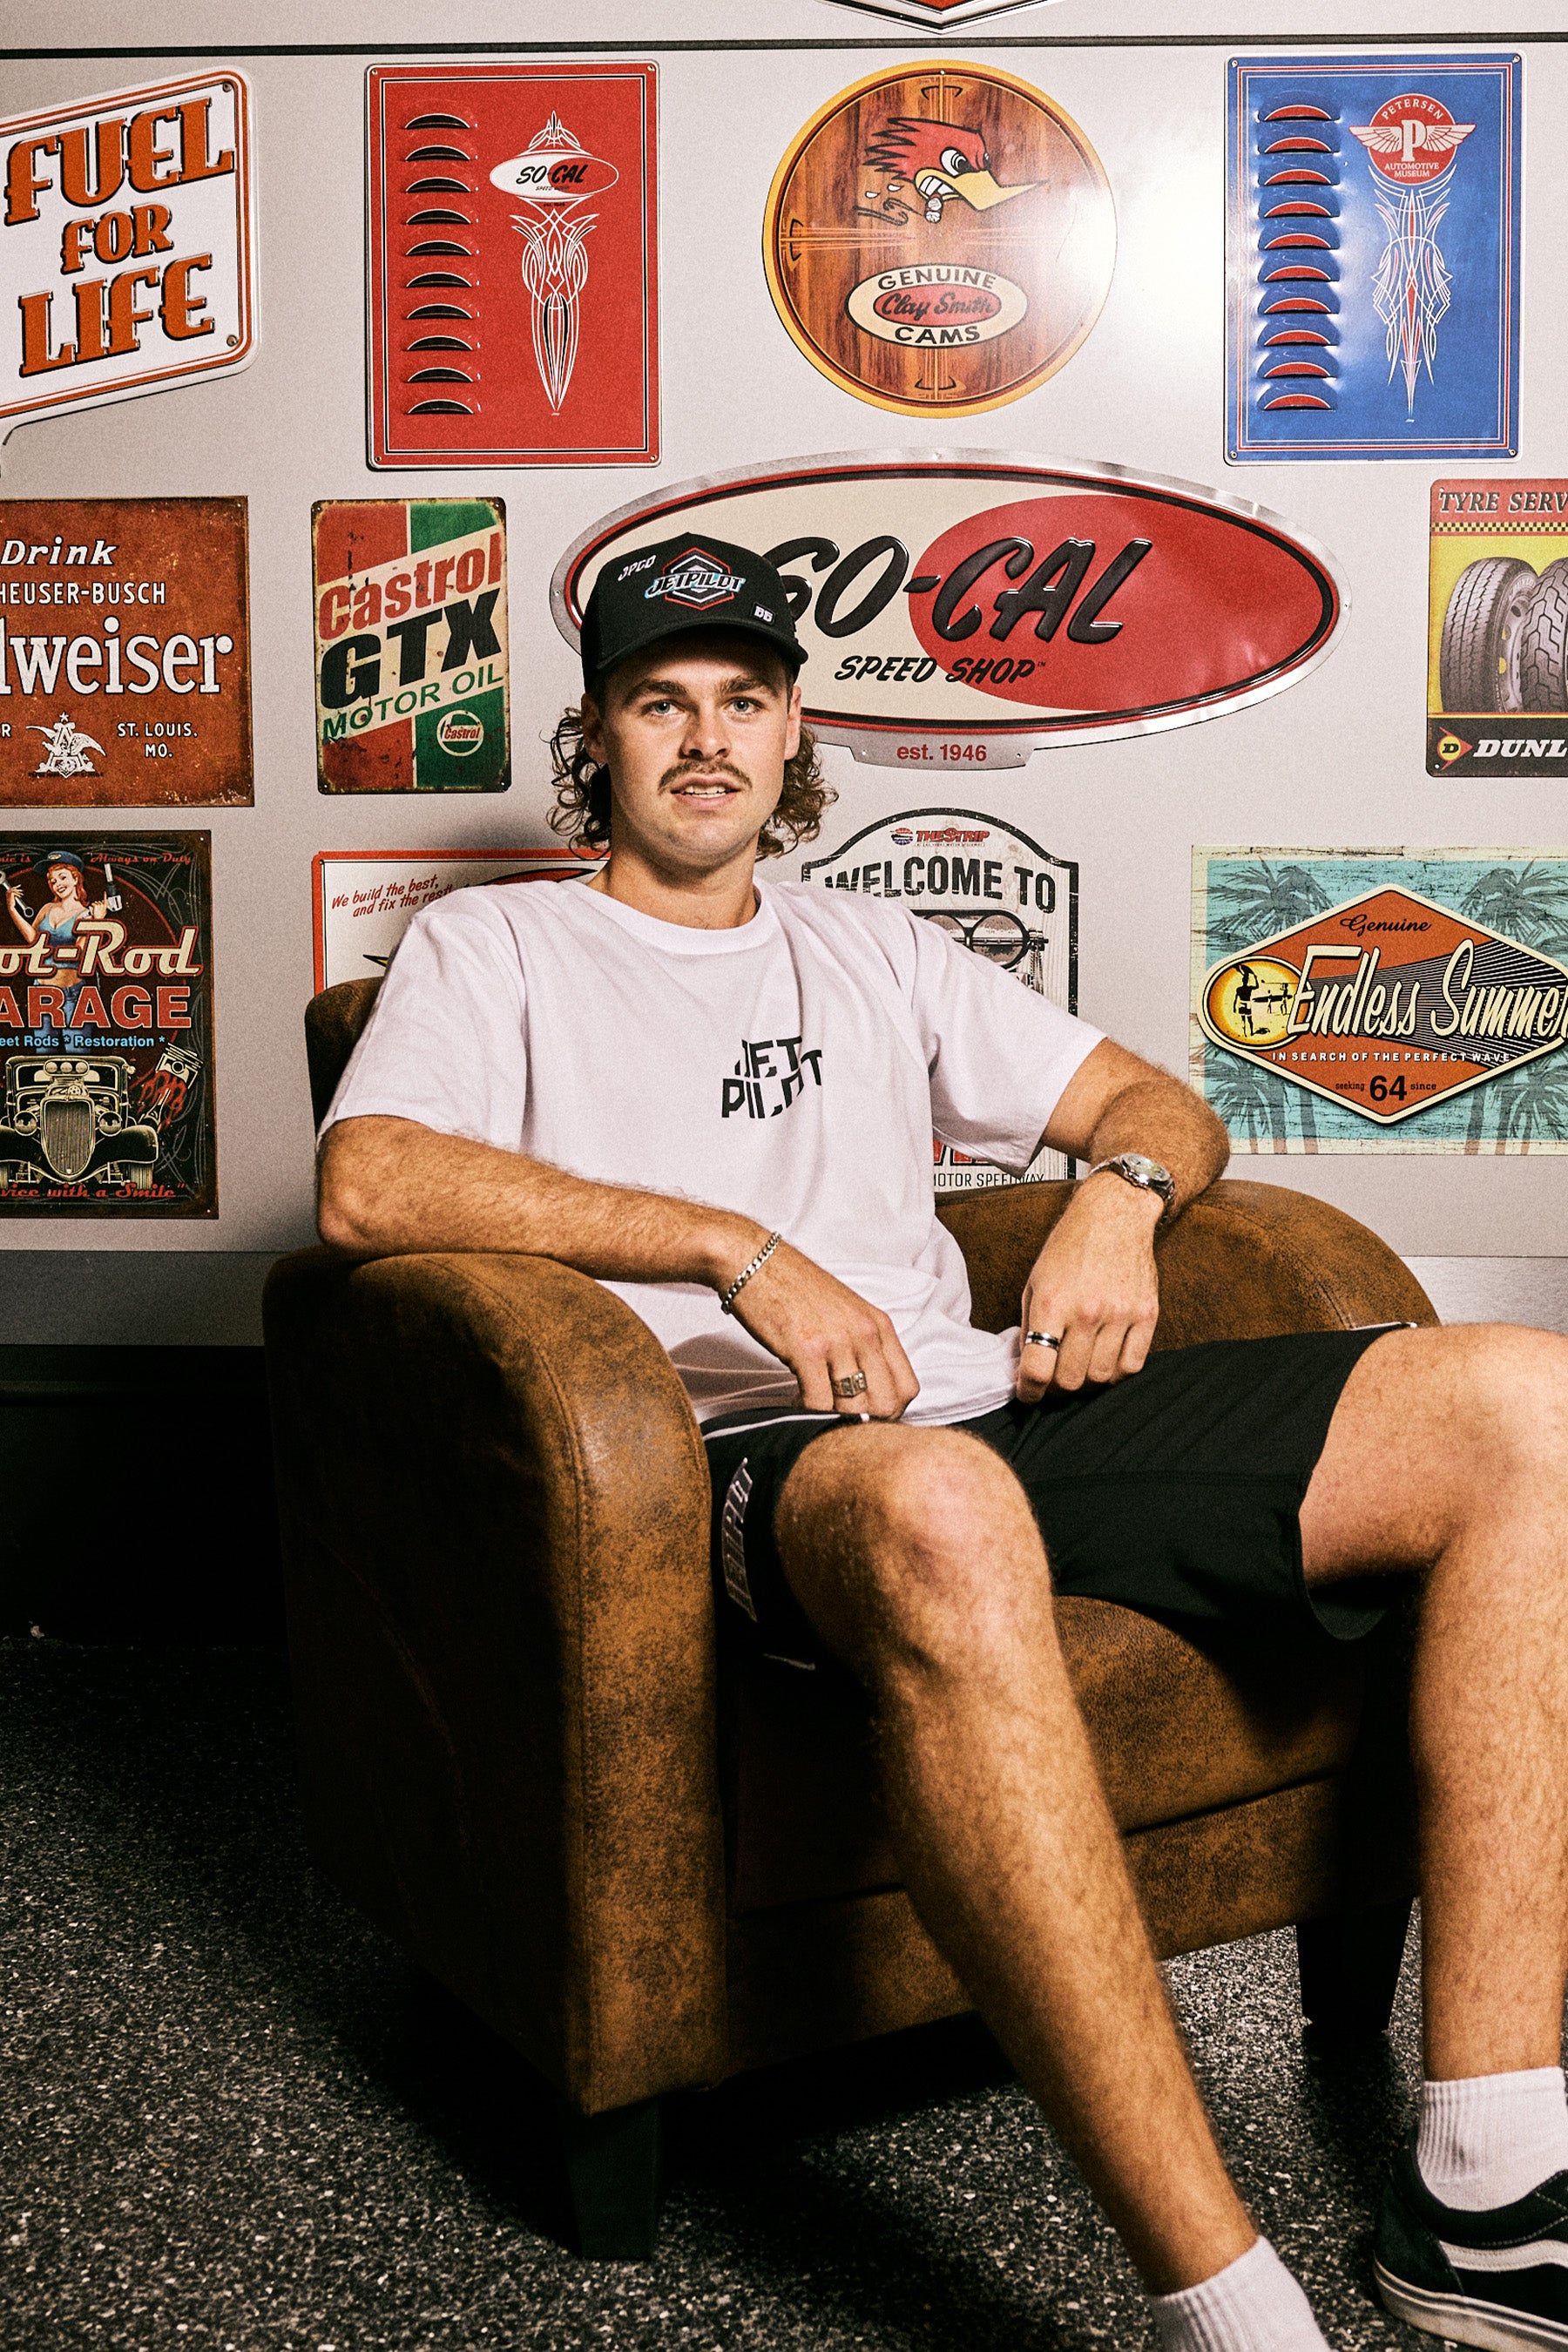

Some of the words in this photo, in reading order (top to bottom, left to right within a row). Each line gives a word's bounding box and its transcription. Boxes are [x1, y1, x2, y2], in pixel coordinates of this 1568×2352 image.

[1382, 98, 1443, 120] PETERSEN
[3, 98, 235, 226] FUEL
[61, 204, 173, 274] FOR
[878, 268, 997, 290] GENUINE
[19, 253, 215, 378] LIFE
[882, 293, 930, 321] Clay
[933, 292, 994, 314] Smith
[895, 326, 981, 344] CAMS
[1438, 491, 1499, 513] TYRE
[1508, 491, 1568, 513] SERV
[0, 536, 118, 566] Drink
[319, 532, 502, 640] Castrol
[645, 571, 747, 598] JETPILOT
[761, 534, 1153, 645] SO-CAL
[321, 587, 502, 710] GTX
[835, 655, 937, 683] SPEED
[323, 682, 441, 740] MOTOR
[452, 663, 504, 694] OIL
[118, 723, 139, 737] ST.
[444, 727, 480, 739] Castrol
[145, 743, 173, 758] MO.
[896, 744, 934, 760] est.
[940, 744, 987, 761] 1946
[1442, 743, 1459, 754] D
[1473, 739, 1568, 758] DUNL
[90, 852, 139, 865] Always
[162, 852, 191, 865] Duty
[331, 894, 349, 909] We
[353, 885, 383, 904] build
[386, 882, 405, 897] the
[408, 874, 439, 893] best,
[825, 855, 1003, 899] WELCOME
[1014, 865, 1057, 914] TO
[353, 900, 376, 917] and
[378, 898, 396, 912] fix
[400, 893, 419, 908] the
[1340, 914, 1433, 937] Genuine
[1287, 944, 1423, 1038] Endless
[24, 1035, 59, 1047] Rods
[75, 1035, 155, 1047] Restoration
[1272, 1052, 1287, 1062] IN
[1291, 1052, 1347, 1062] SEARCH
[1352, 1052, 1369, 1062] OF
[1373, 1052, 1400, 1062] THE
[1404, 1052, 1467, 1062] PERFECT
[1471, 1052, 1511, 1062] WAVE
[1335, 1081, 1365, 1092] seeking
[1369, 1075, 1408, 1101] 64
[1410, 1081, 1437, 1091] since
[46, 1183, 91, 1198] with
[95, 1189, 109, 1198] a
[934, 1173, 971, 1186] OTOR
